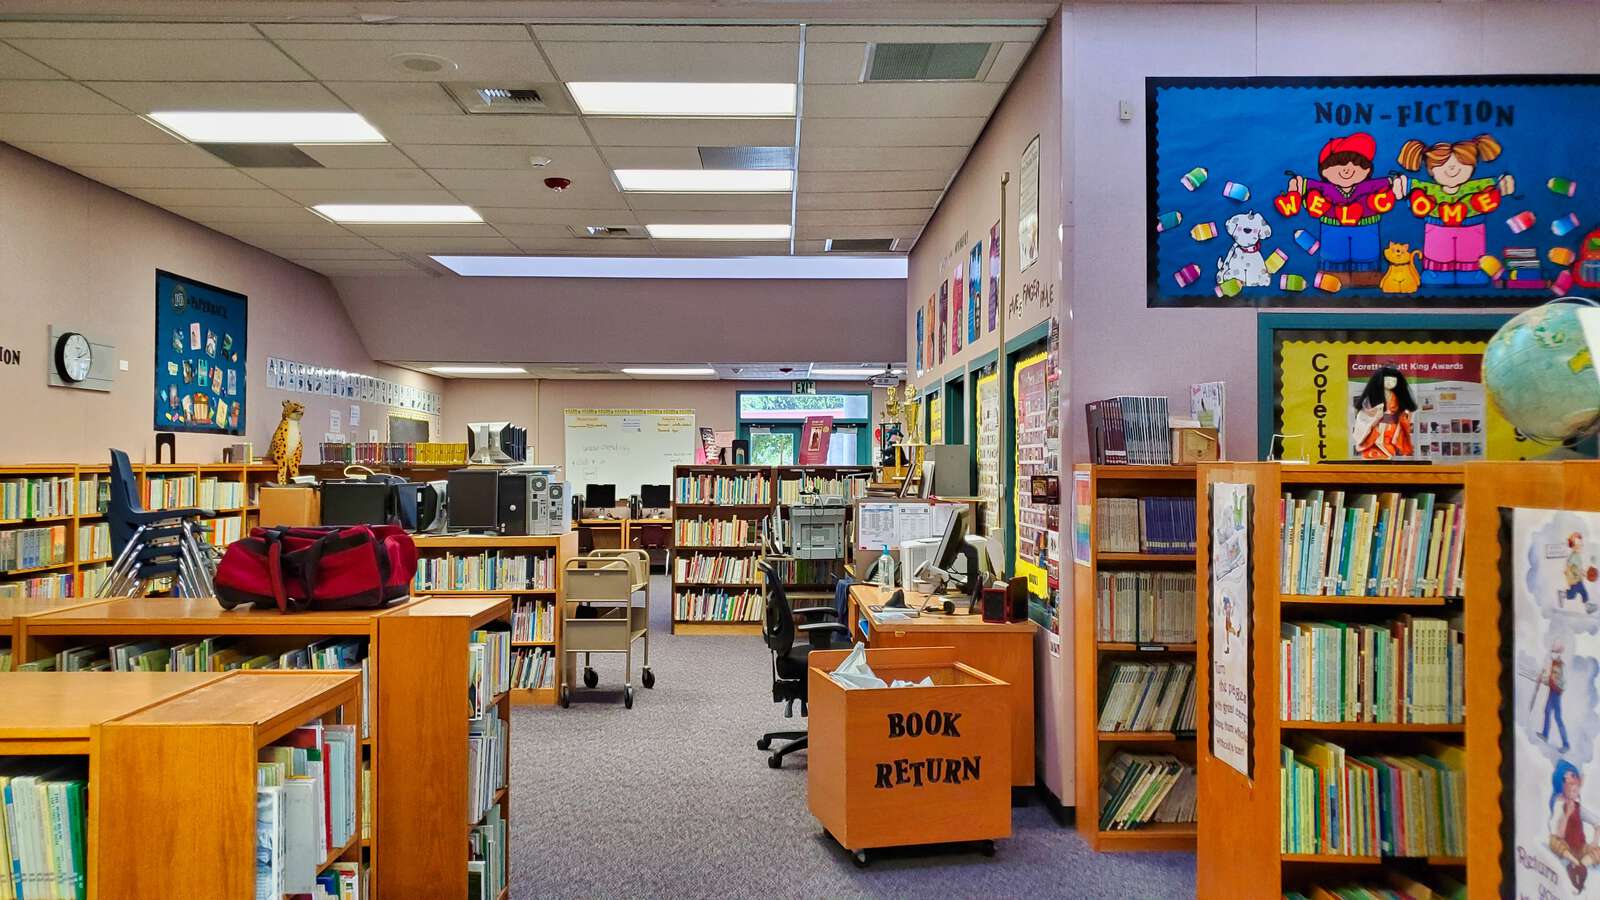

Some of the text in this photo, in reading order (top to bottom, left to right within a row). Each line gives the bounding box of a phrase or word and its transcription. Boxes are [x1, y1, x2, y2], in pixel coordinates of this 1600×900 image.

[1410, 363, 1429, 371] King
[1312, 353, 1329, 464] Corett
[888, 709, 962, 738] BOOK
[875, 756, 981, 788] RETURN
